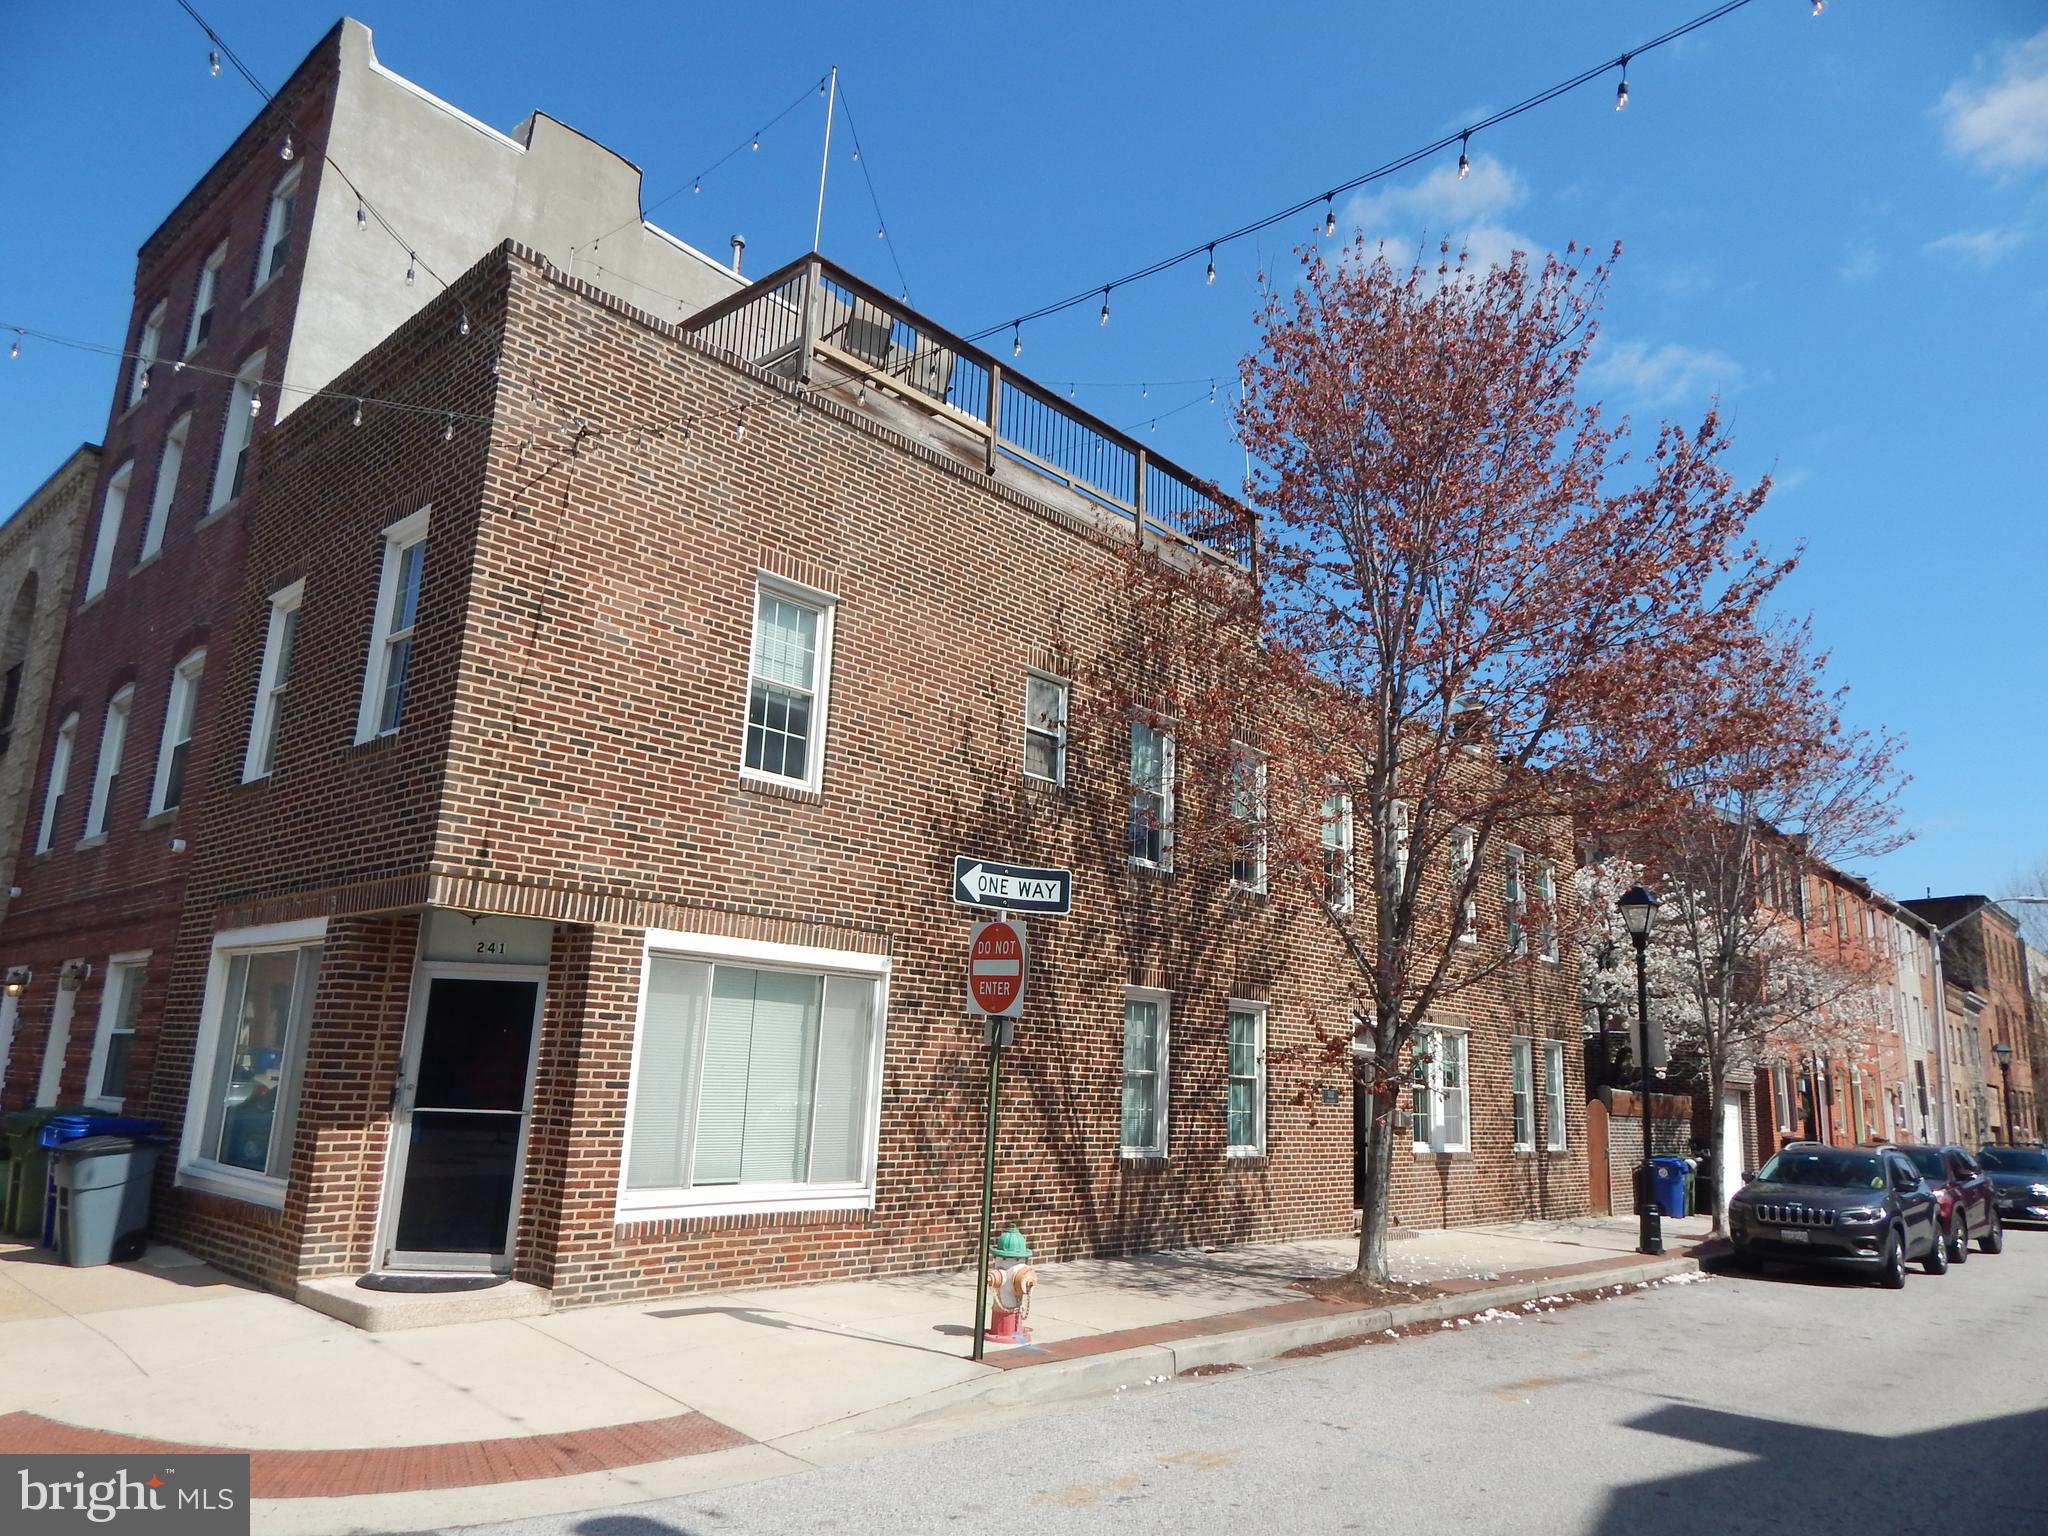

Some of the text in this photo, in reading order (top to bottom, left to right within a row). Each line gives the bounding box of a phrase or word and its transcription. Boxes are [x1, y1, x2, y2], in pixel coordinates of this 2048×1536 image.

[978, 875, 1057, 899] ONE WAY
[477, 942, 505, 955] 241
[978, 940, 1016, 955] DO NOT
[979, 981, 1010, 996] ENTER
